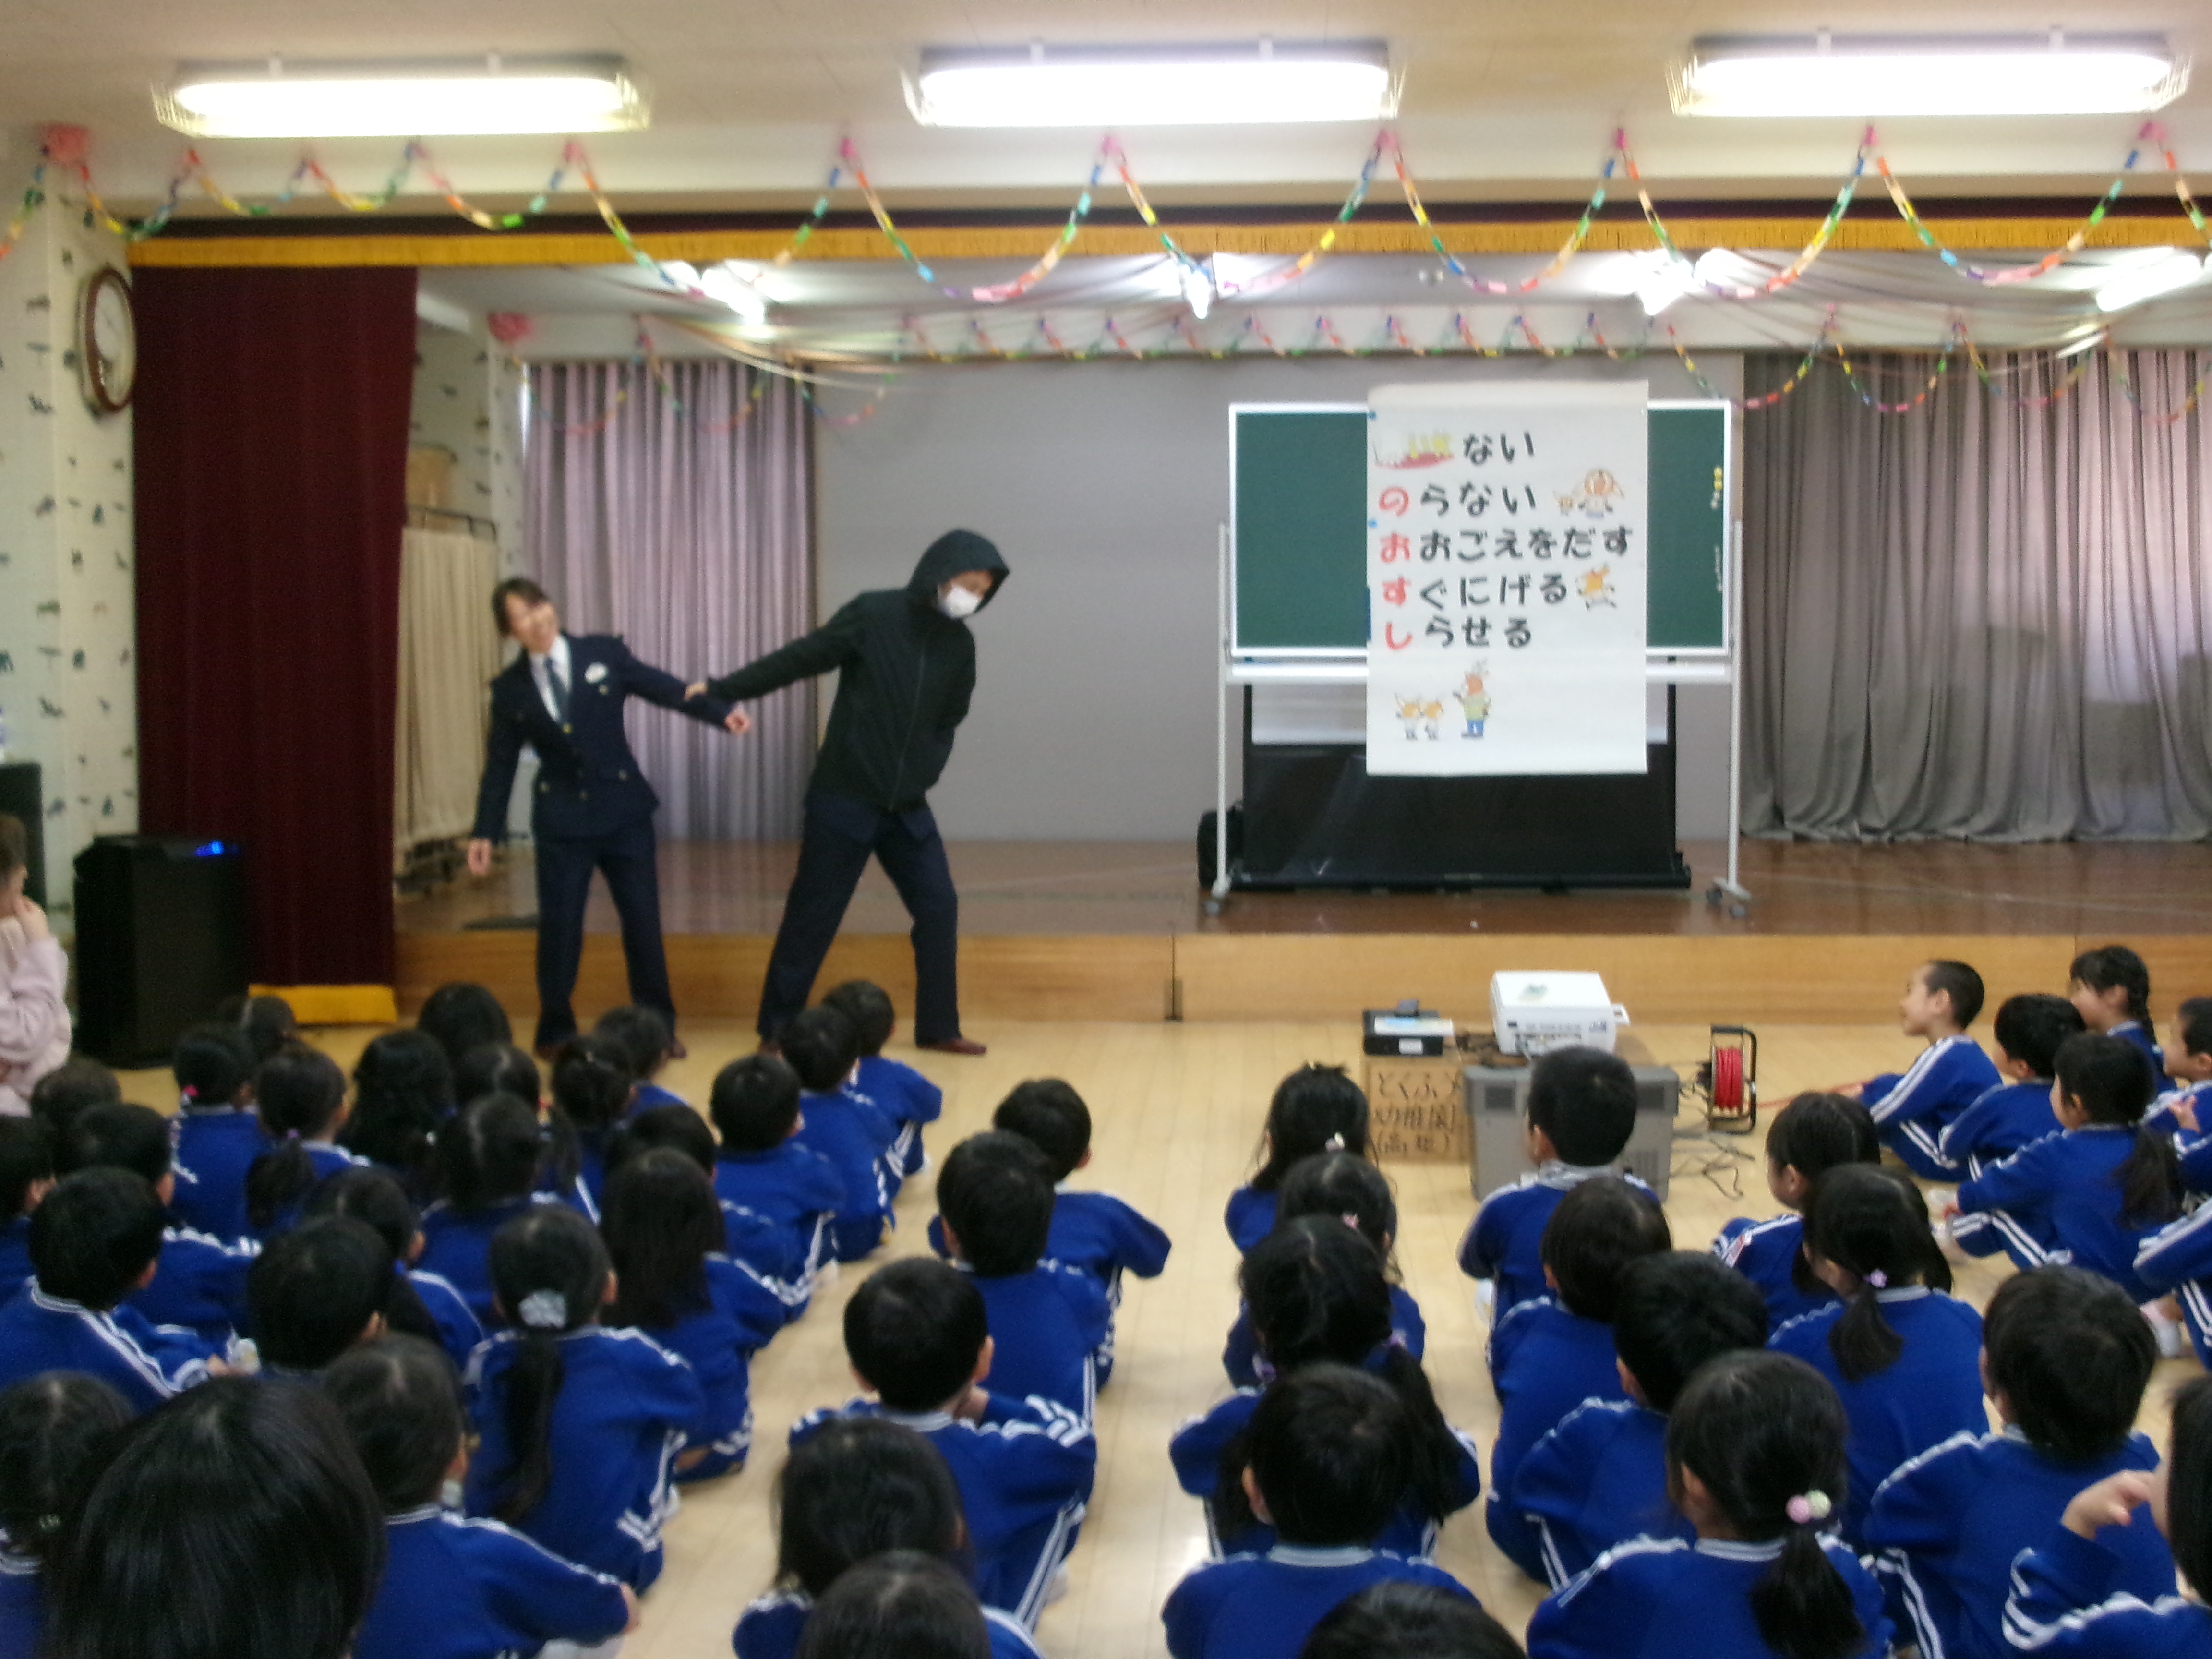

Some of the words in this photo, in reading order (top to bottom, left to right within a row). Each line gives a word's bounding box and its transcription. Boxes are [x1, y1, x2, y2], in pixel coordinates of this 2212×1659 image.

[1463, 433, 1534, 466] ない
[1379, 481, 1536, 517] のらない
[1379, 526, 1633, 564] おおごえをだす
[1381, 574, 1568, 611] すぐにげる
[1385, 615, 1532, 651] しらせる
